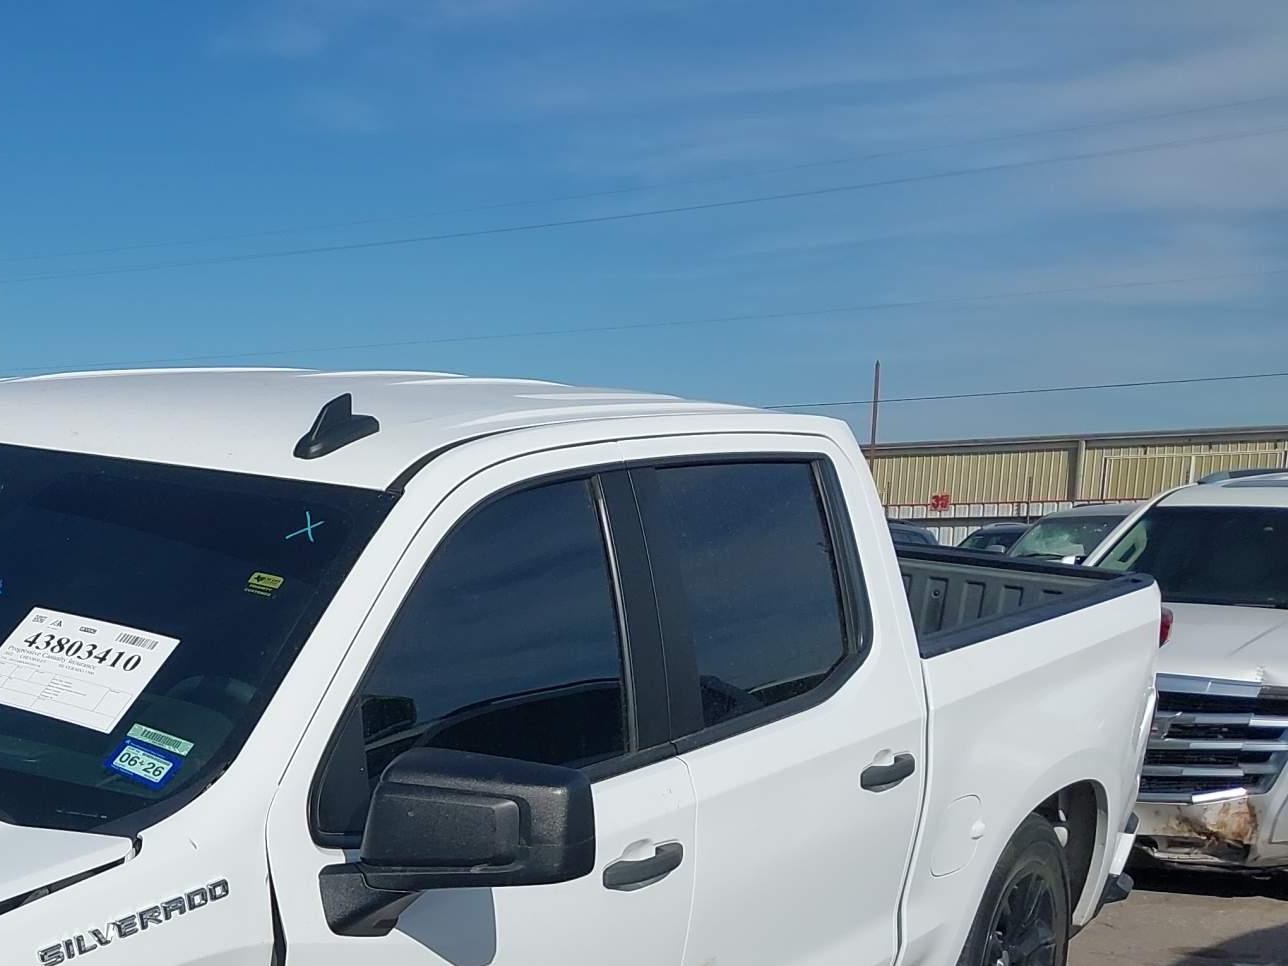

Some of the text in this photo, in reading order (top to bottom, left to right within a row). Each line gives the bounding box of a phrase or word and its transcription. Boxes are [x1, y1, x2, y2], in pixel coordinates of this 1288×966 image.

[23, 631, 142, 672] 43803410
[119, 752, 140, 767] 06
[142, 762, 165, 777] 26
